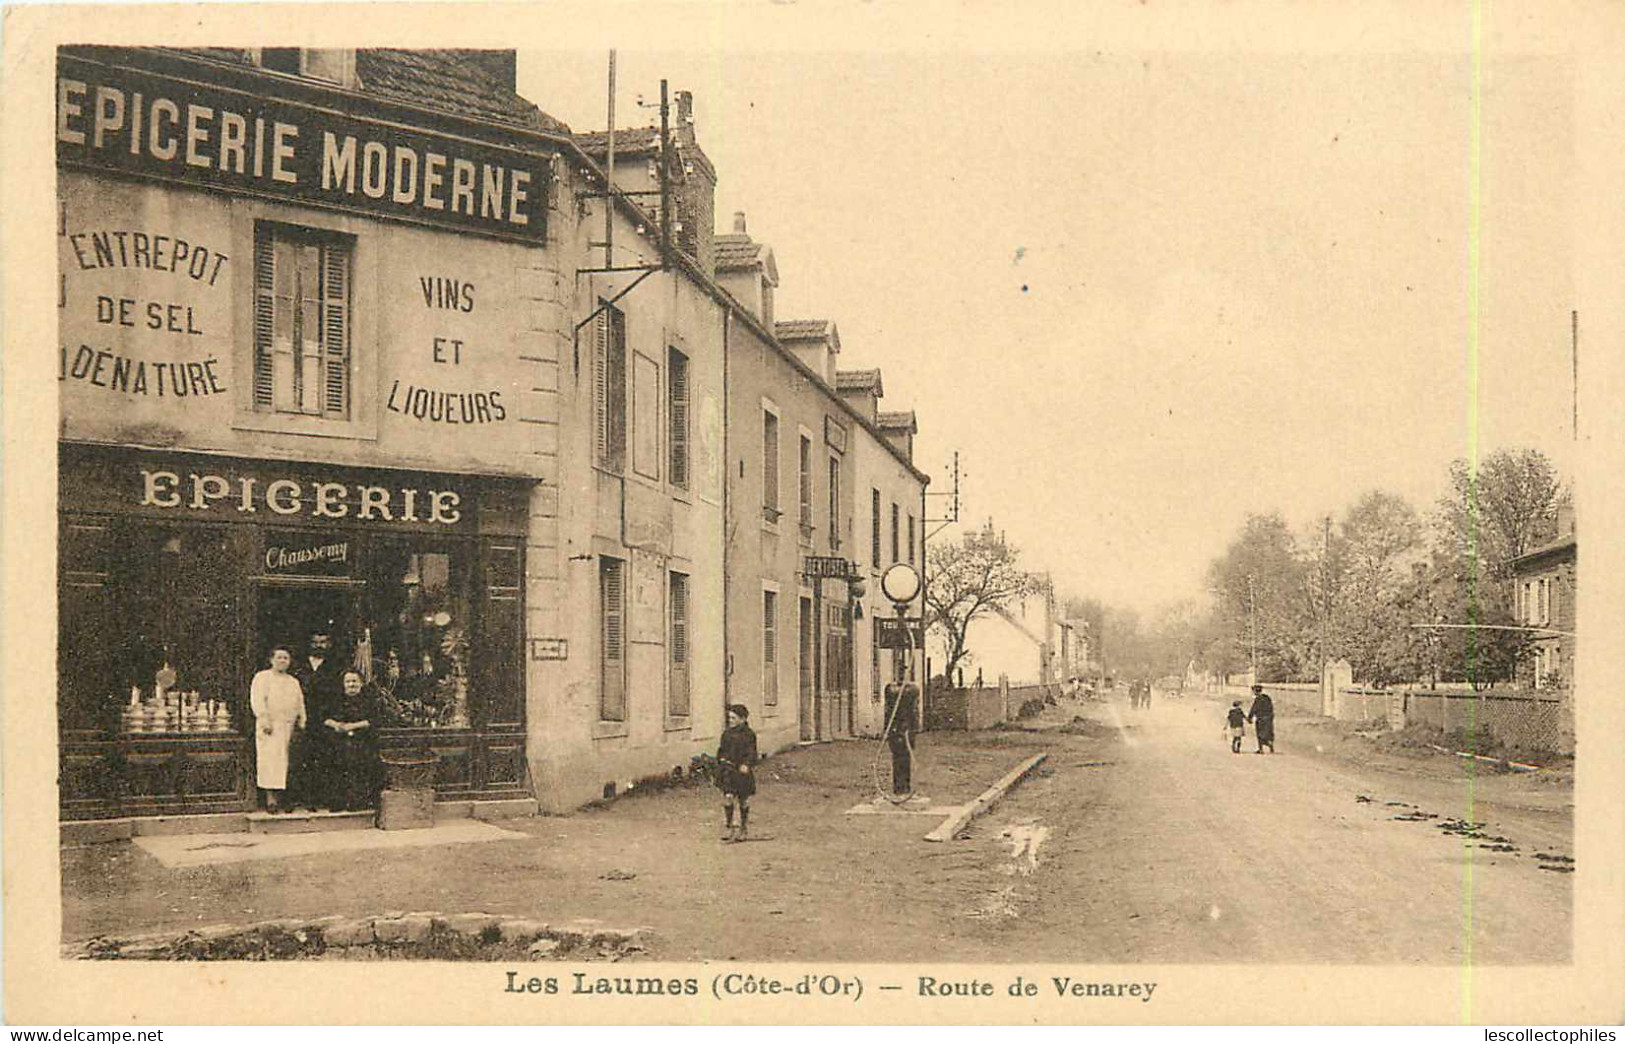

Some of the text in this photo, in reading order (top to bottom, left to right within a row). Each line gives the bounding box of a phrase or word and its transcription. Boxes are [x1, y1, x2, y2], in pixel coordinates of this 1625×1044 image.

[57, 78, 532, 226] EPICERIE MODERNE
[70, 231, 228, 286] ENTREPOT
[97, 295, 203, 335] DE SEL
[420, 276, 475, 313] VINS
[70, 344, 227, 397] DÉNATURÉ
[433, 337, 464, 365] ET
[387, 379, 506, 424] LIQUEURS
[140, 470, 462, 524] EPICERIE
